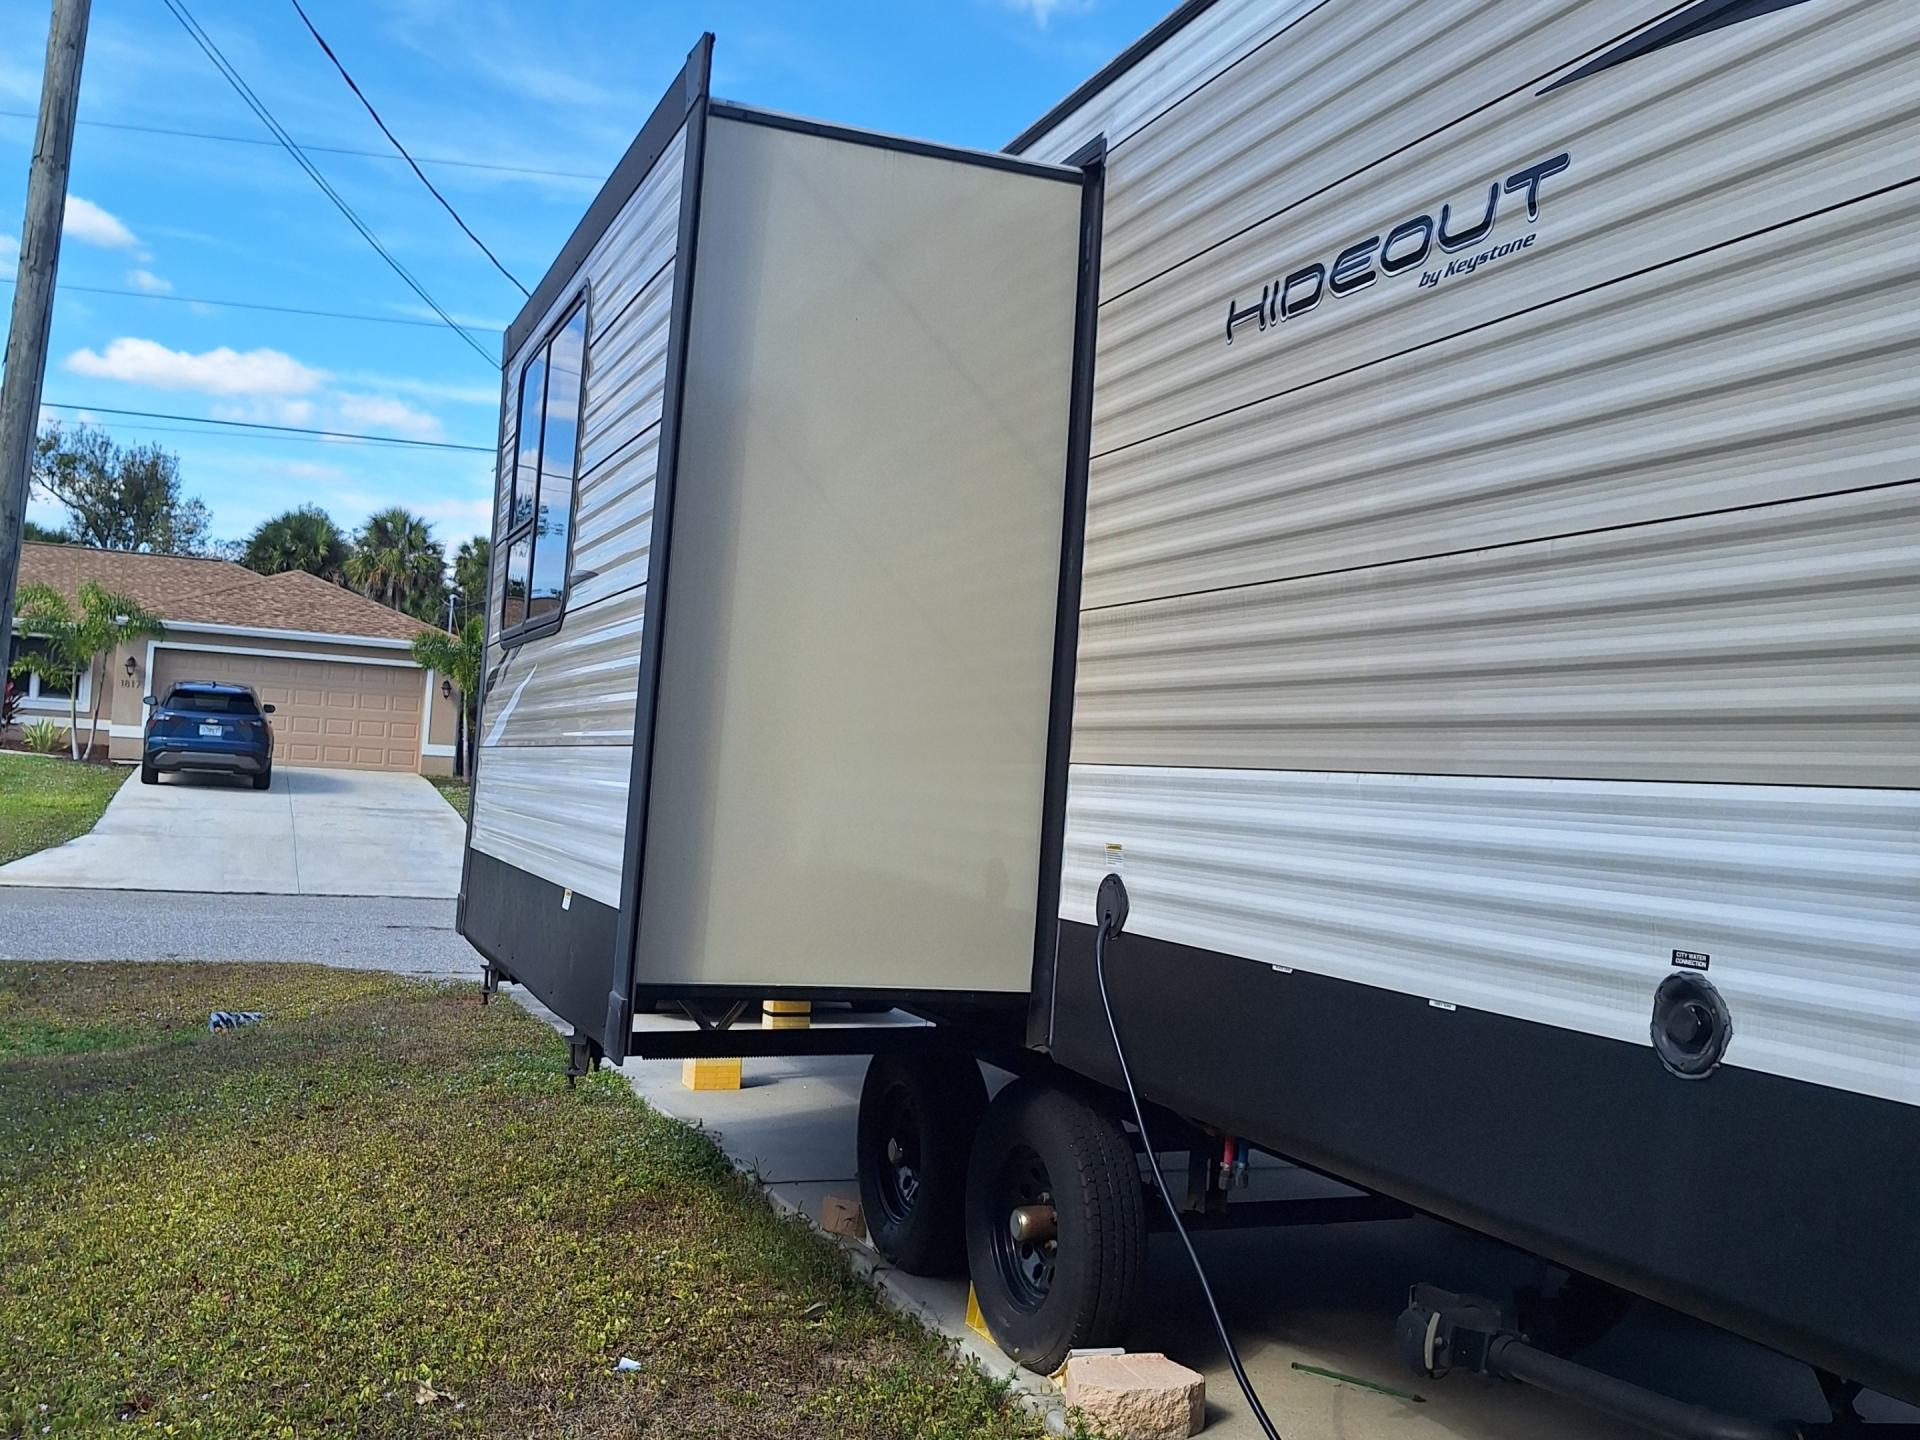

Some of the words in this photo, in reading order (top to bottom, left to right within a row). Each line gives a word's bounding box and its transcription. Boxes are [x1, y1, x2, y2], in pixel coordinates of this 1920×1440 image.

[1225, 152, 1571, 345] HIDEOUT
[1418, 269, 1442, 288] by
[1444, 233, 1537, 278] Keystone
[1676, 958, 1706, 968] CONNECTION
